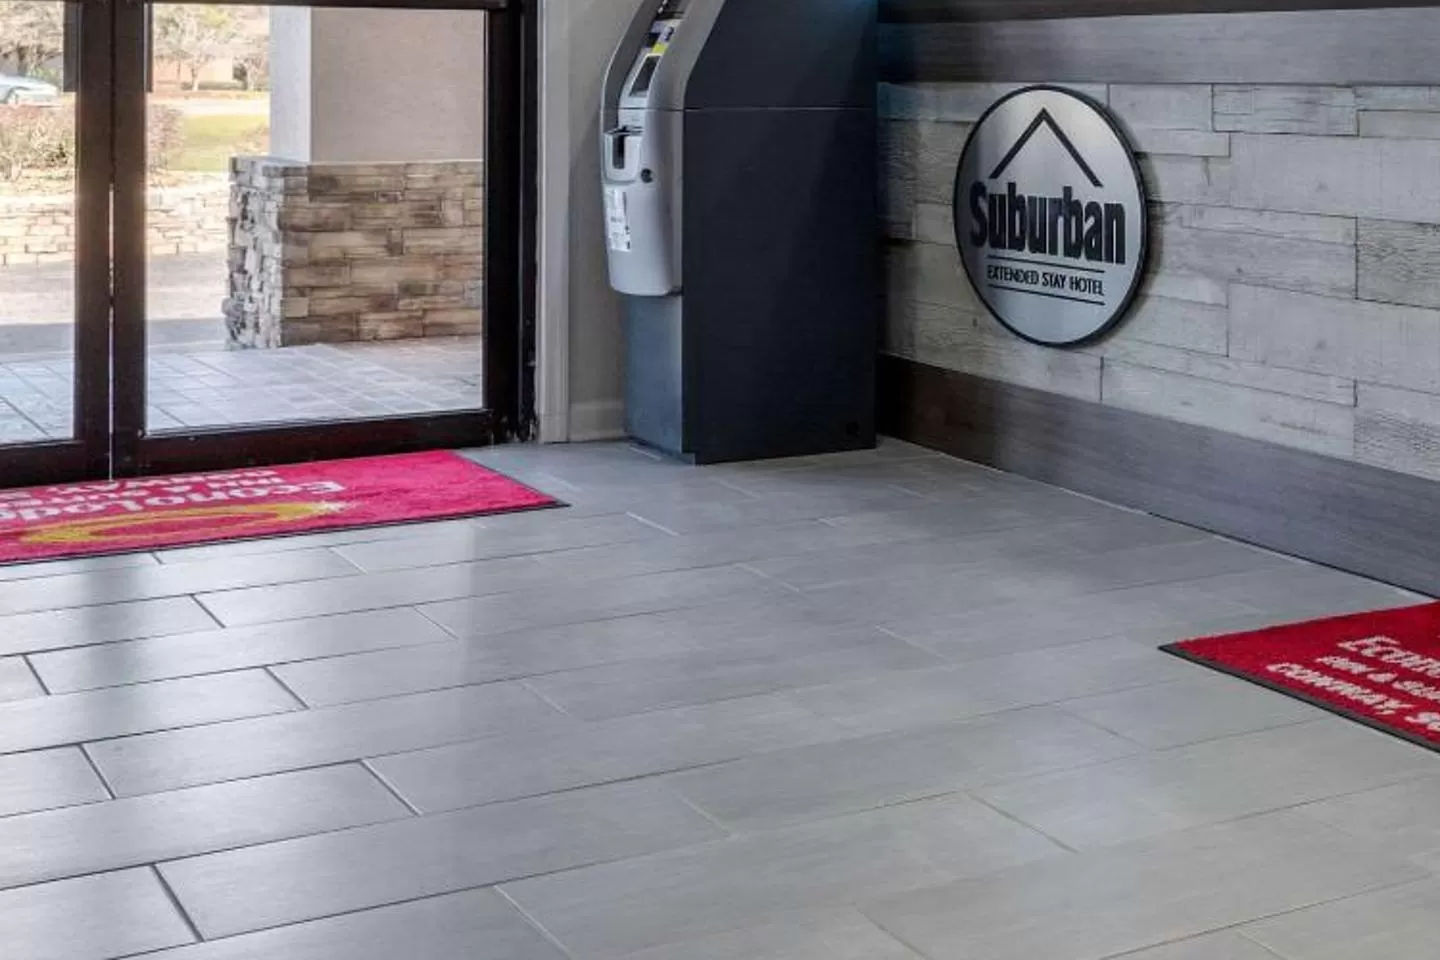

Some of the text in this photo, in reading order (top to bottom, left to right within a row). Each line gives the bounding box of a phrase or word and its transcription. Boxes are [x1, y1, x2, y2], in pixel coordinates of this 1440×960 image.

[970, 180, 1126, 265] Suburban
[987, 264, 1104, 296] EXTENDED STAY HOTEL
